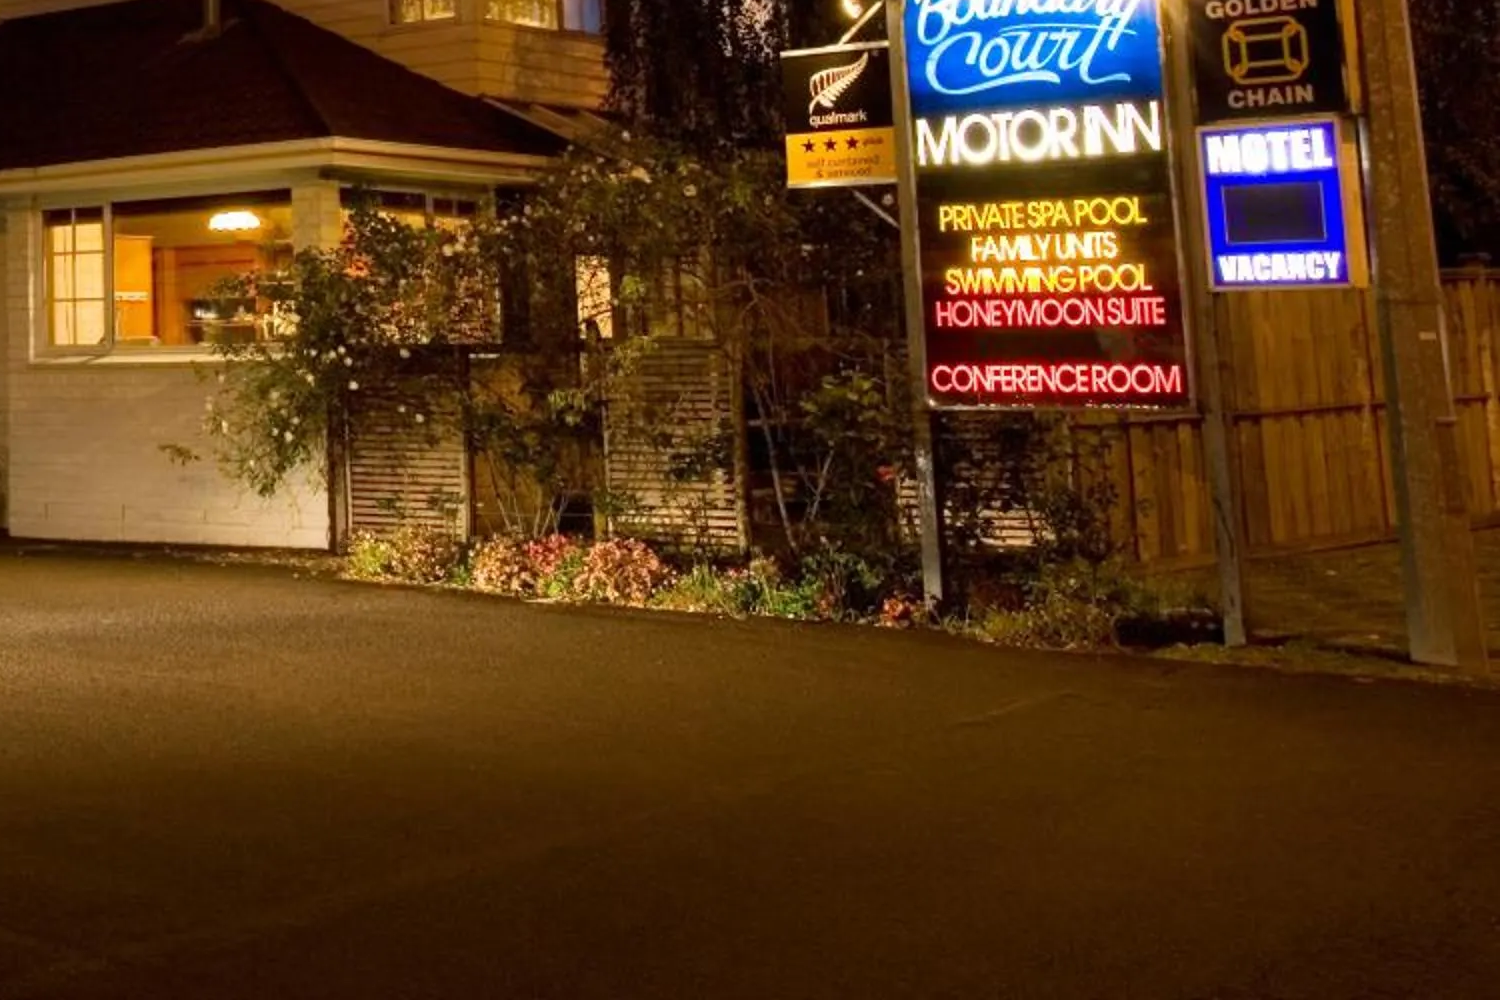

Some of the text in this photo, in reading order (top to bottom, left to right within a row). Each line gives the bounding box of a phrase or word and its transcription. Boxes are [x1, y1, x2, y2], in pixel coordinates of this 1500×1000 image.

[925, 19, 1137, 95] Court
[1228, 83, 1314, 109] CHAIN
[809, 109, 868, 129] qualmark
[915, 101, 1161, 166] MOTOR INN
[1206, 128, 1333, 174] MOTEL
[939, 197, 1148, 232] PRIVATE SPA POOL
[971, 231, 1119, 261] FAMILY UNITS
[945, 263, 1153, 294] SWIMMING POOL
[1217, 252, 1341, 282] VACANCY
[935, 297, 1166, 327] HONEYMOON SUITE
[931, 365, 1182, 393] CONFERENCE ROOM
